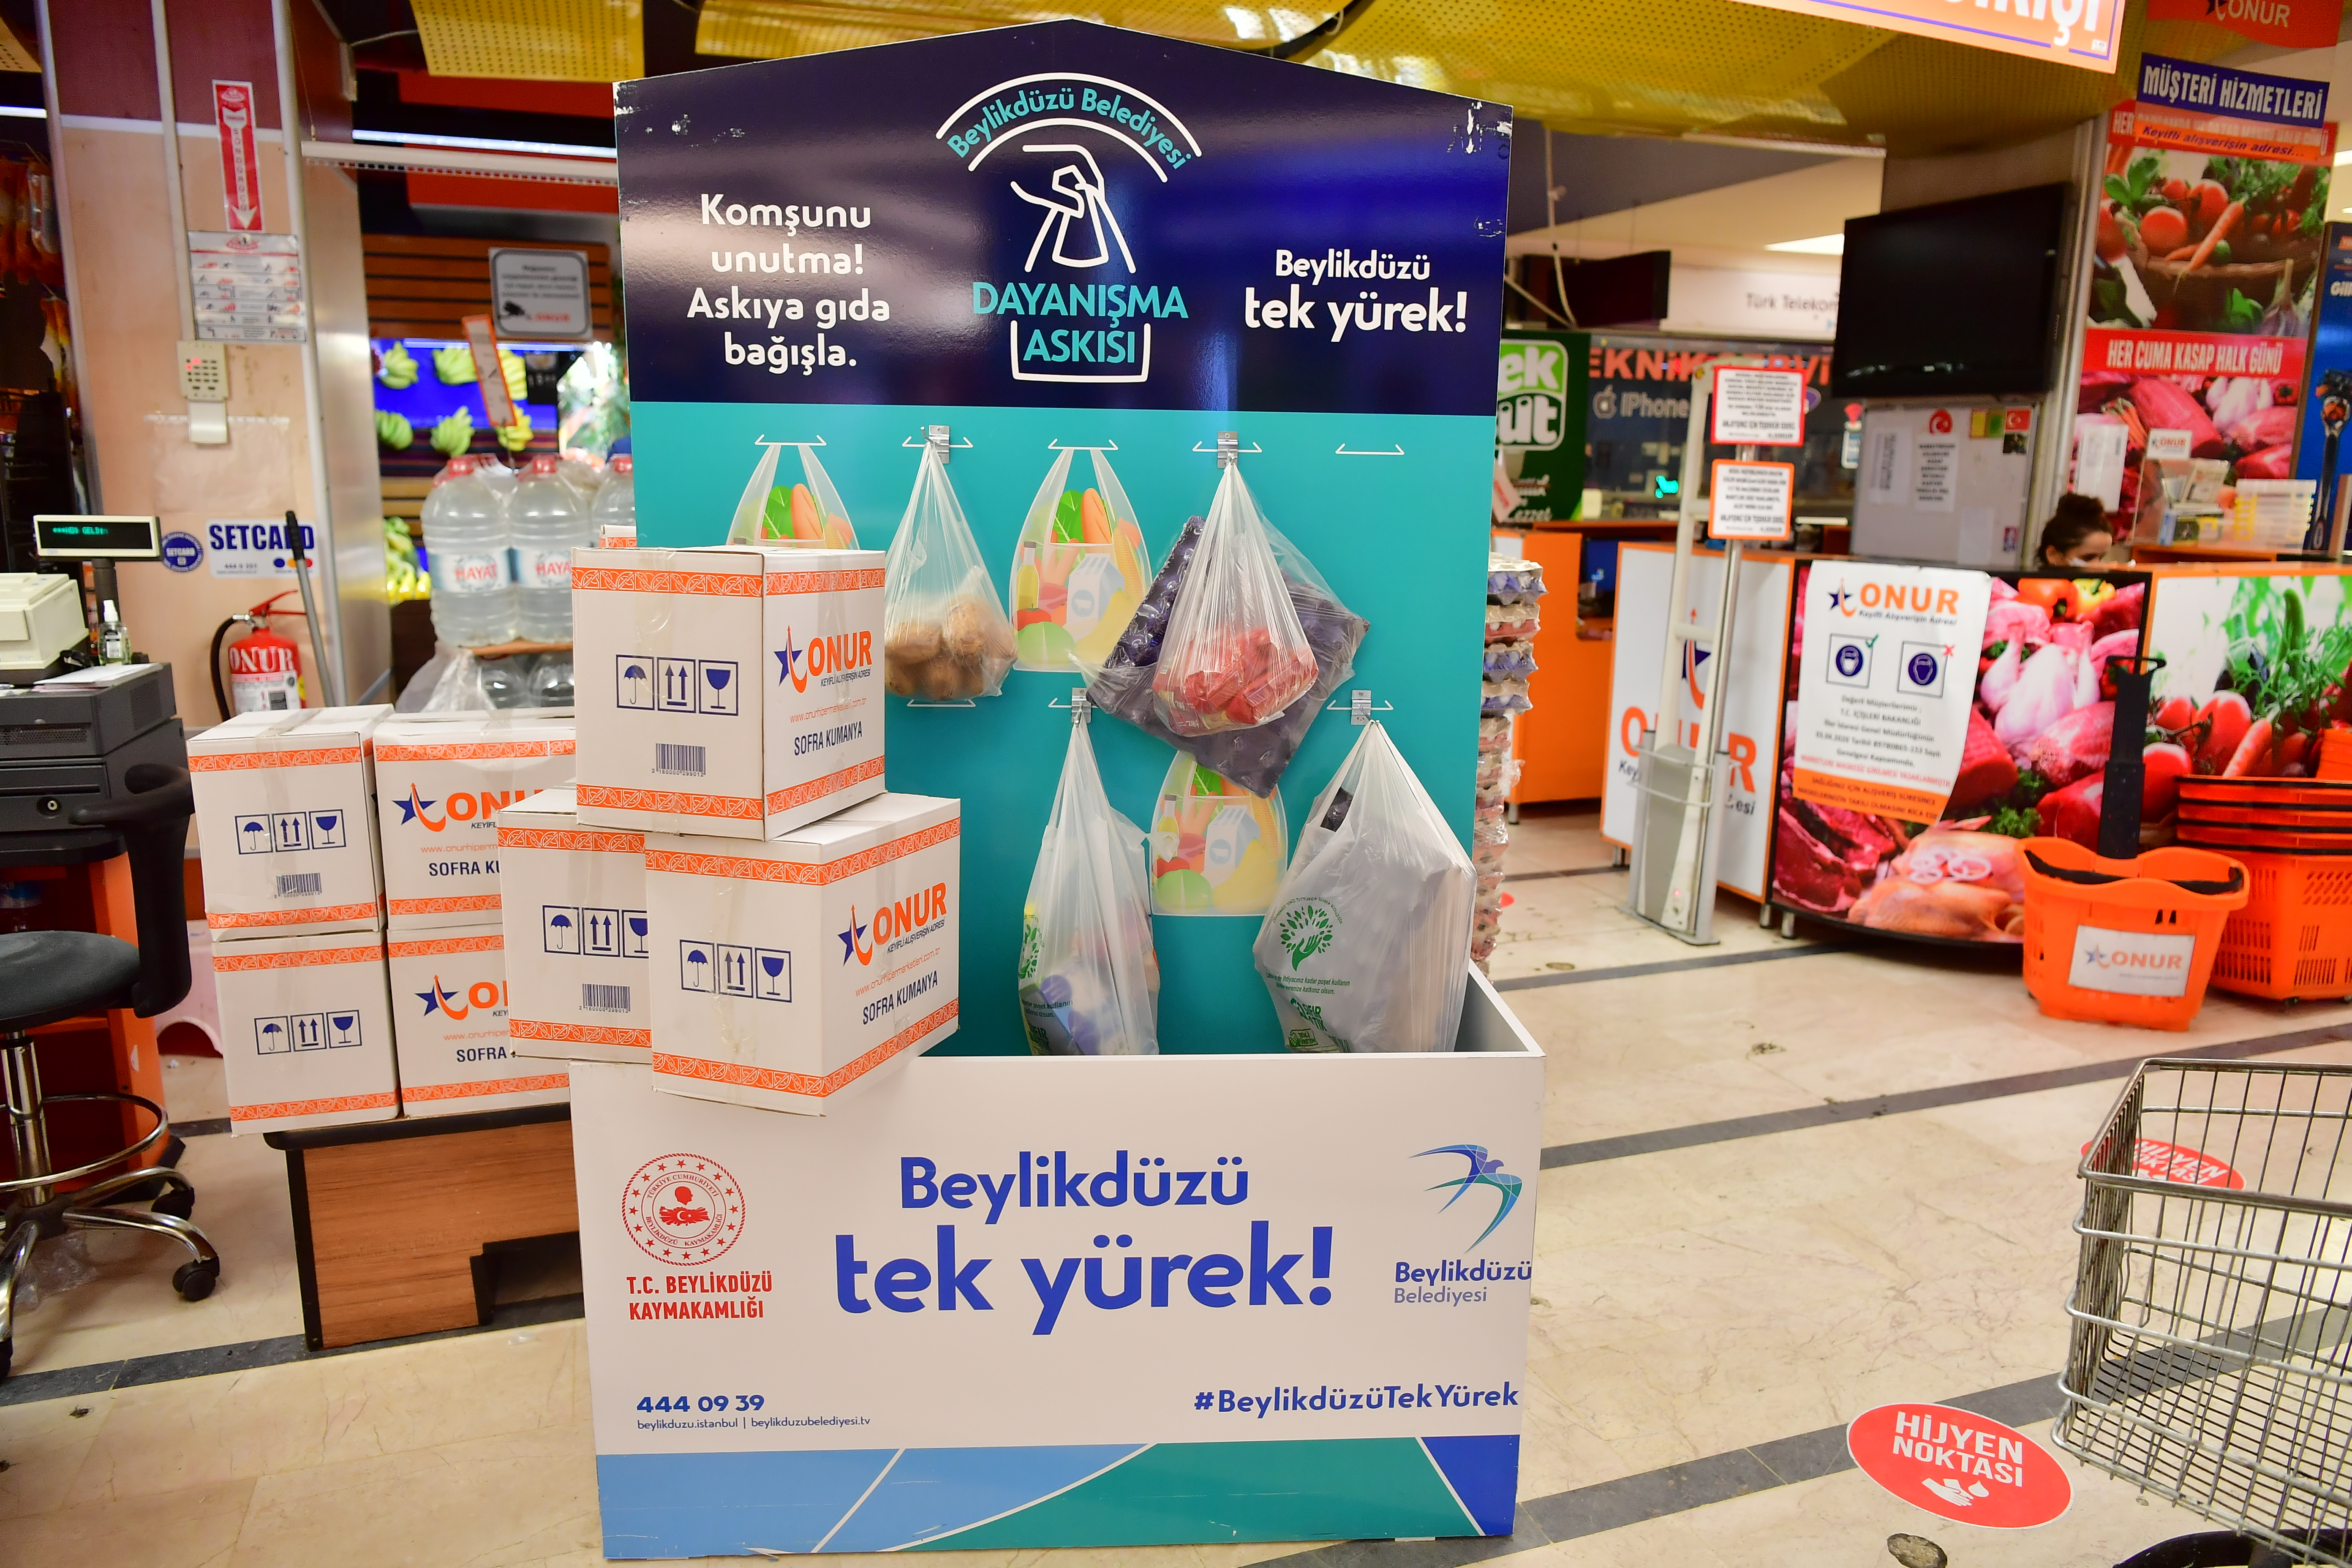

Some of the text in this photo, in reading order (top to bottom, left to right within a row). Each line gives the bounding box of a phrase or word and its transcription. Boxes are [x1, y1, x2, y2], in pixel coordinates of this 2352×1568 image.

[2228, 0, 2290, 27] ONUR
[2142, 63, 2323, 120] MÜŞTERİ HİZMETLERİ
[947, 87, 1192, 170] Beylikdüzü Belediyesi
[701, 193, 871, 237] Komşunu
[711, 243, 863, 275] unutma!
[1275, 248, 1430, 286] Beylikdüzü
[686, 286, 890, 329] Askıya gıda
[972, 282, 1189, 329] DAYANIŞMA
[1245, 283, 1467, 342] tek yürek!
[724, 331, 857, 376] bağışla.
[1023, 329, 1136, 364] ASKISI
[2107, 339, 2283, 376] HER CUMA KASAP HALK GÜNÜ
[455, 563, 498, 581] HAYAT
[1860, 582, 1959, 615] ONUR
[229, 645, 294, 672] ONUR
[807, 630, 873, 677] ONUR
[794, 721, 863, 757] SOFRA KUMANYA
[428, 860, 481, 877] SOFRA
[873, 882, 947, 946] ONUR
[2112, 951, 2183, 970] ONUR
[863, 970, 938, 1026] SOFRA KUMANYA
[1318, 978, 1331, 986] poşet
[456, 1046, 507, 1063] SOFRA
[647, 1174, 720, 1199] TÜRKİYE CUMHURİYETİ
[900, 1149, 1248, 1225] Beylikdüzü
[645, 1214, 723, 1247] BEYLİKDÜZÜ KAYMAKAMLIĞI
[626, 1270, 773, 1294] T.C. BEYLİKDÜZÜ
[835, 1220, 1333, 1335] tek yürek!
[1394, 1258, 1532, 1286] Beylikdüzü
[629, 1296, 764, 1320] KAYMAKAMLIĞI
[1394, 1286, 1487, 1307] Belediyesi
[636, 1394, 765, 1413] 444 09 39
[1194, 1381, 1519, 1418] #BeylikdüzüTekYürek
[637, 1415, 871, 1432] beylikduzu.istanbul beylikduzubelediyesi.tv
[1895, 1411, 2023, 1465] HİJYEN
[1892, 1435, 2023, 1487] NOKTASI
